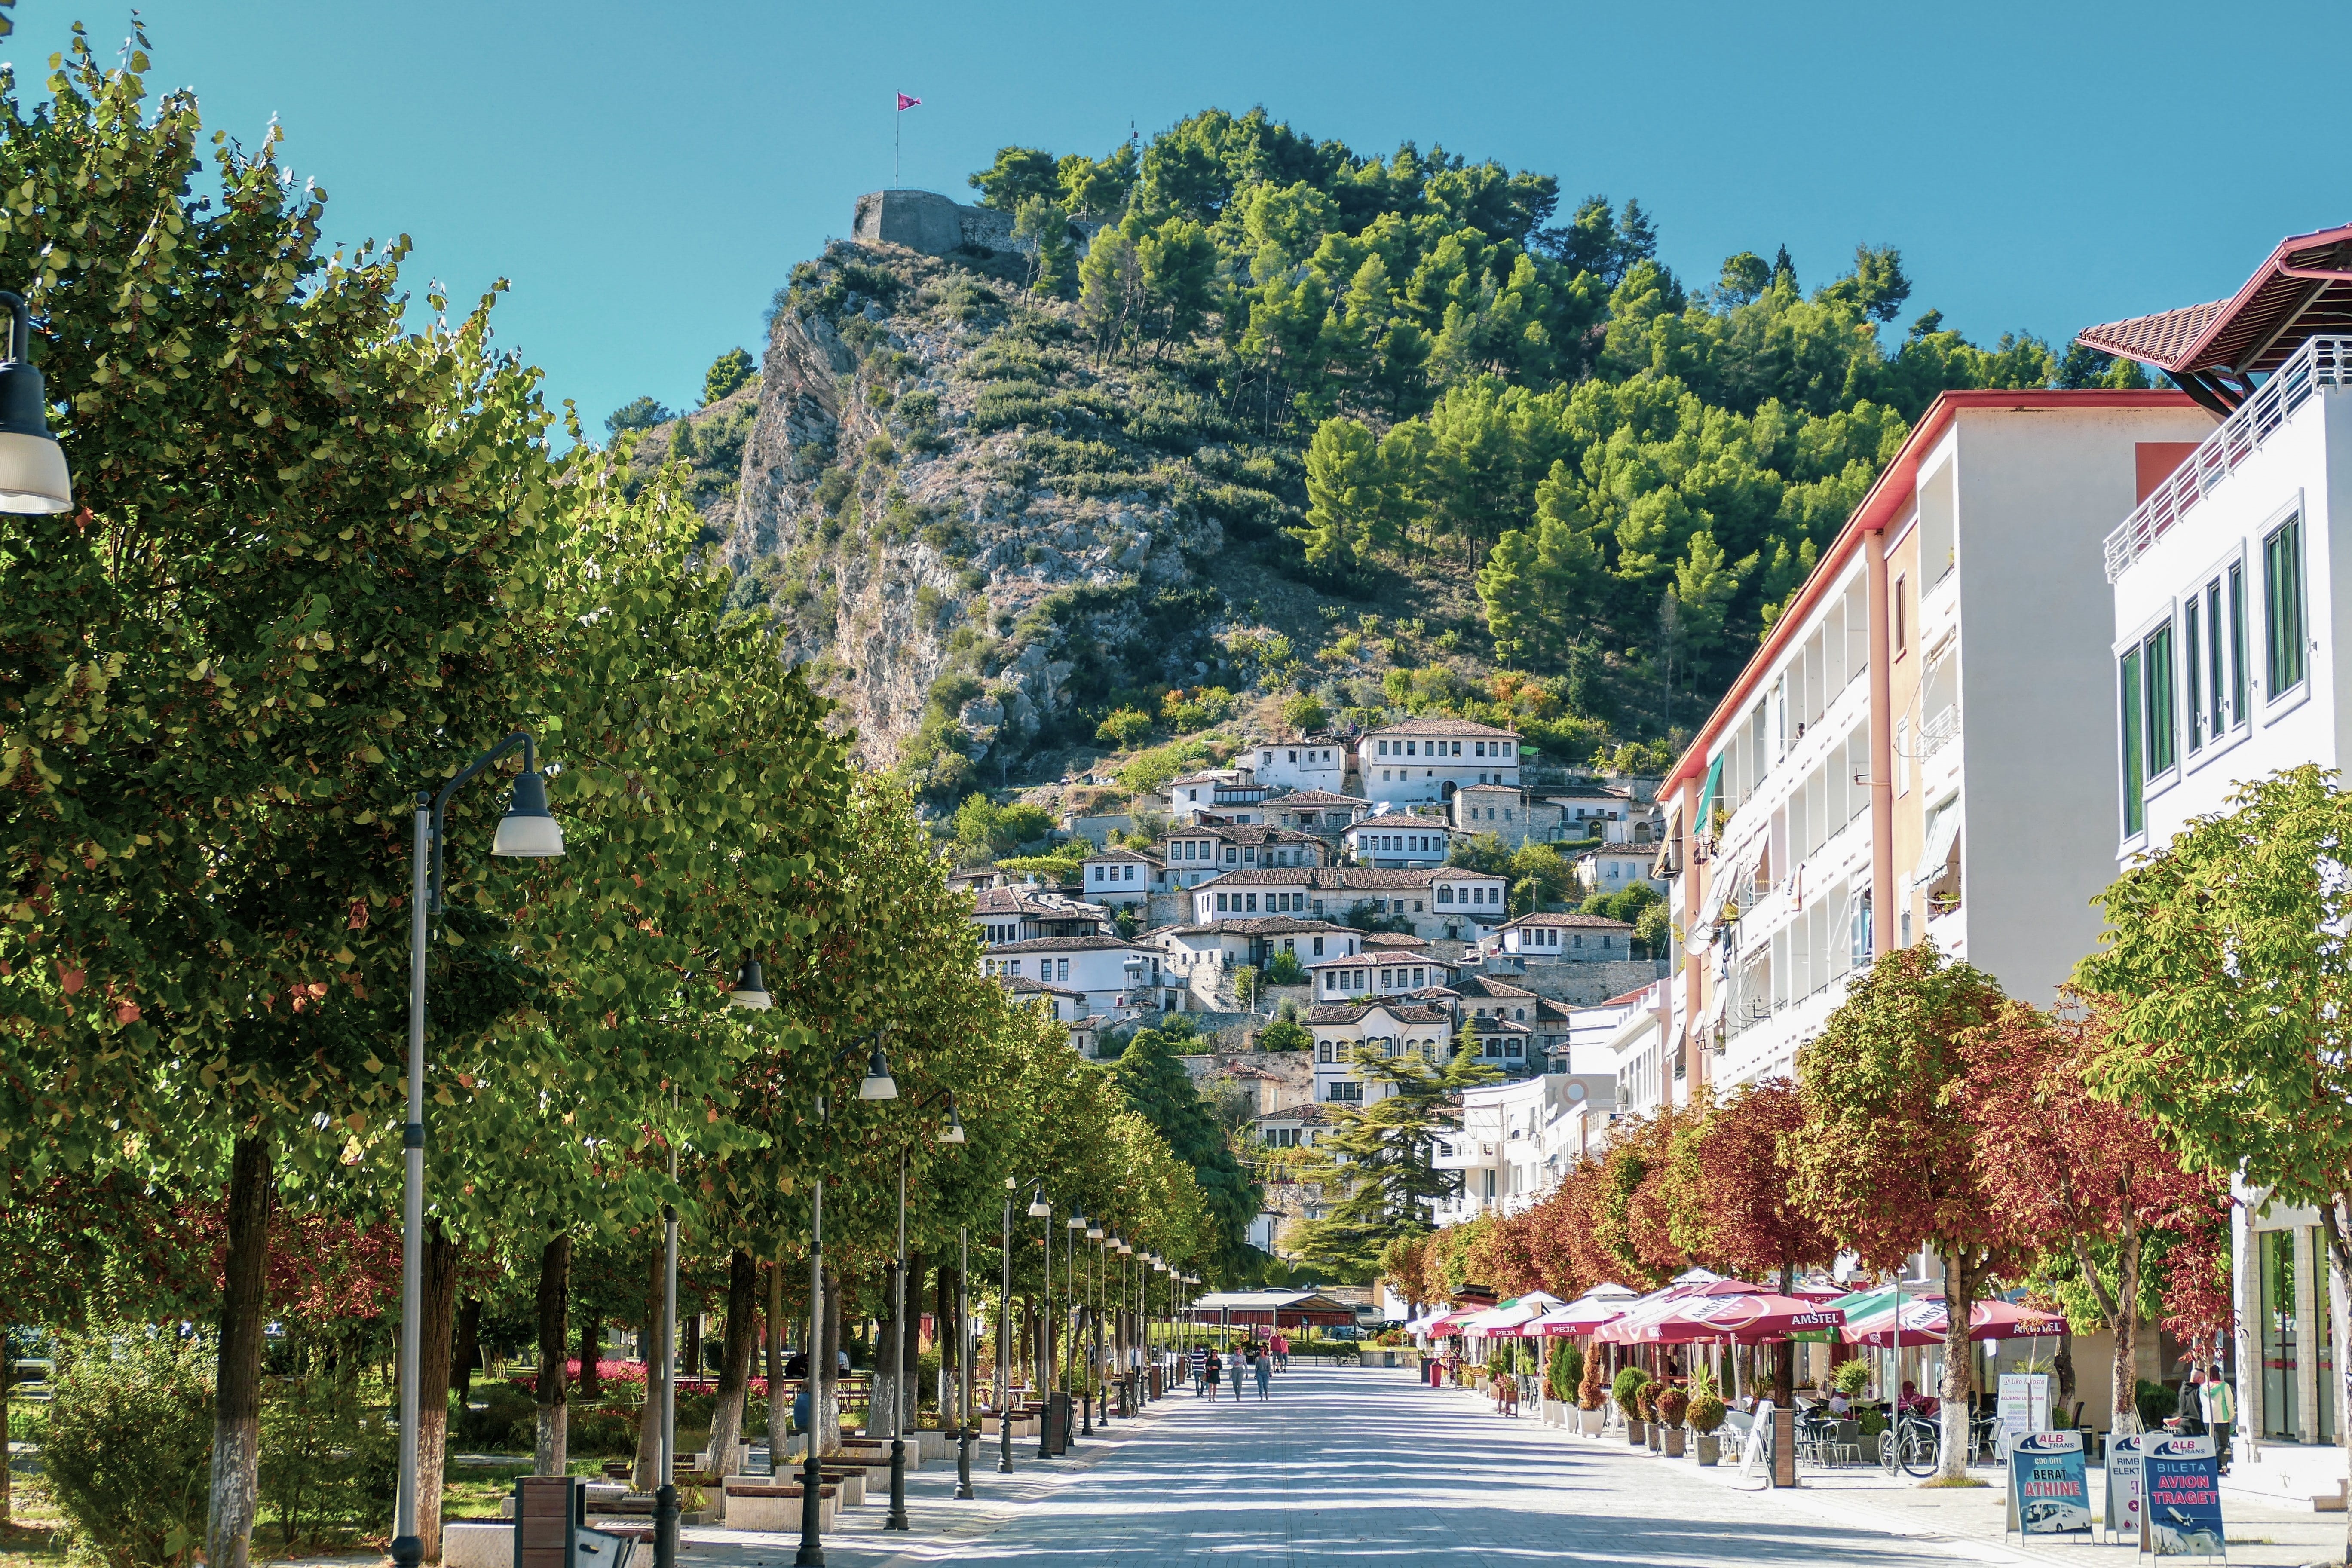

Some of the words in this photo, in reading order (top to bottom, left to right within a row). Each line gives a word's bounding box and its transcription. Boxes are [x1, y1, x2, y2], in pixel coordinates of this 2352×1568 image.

[1692, 1293, 1736, 1319] AMSTEL
[1718, 1303, 1746, 1317] BEER
[1792, 1314, 1839, 1325] AMSTEL
[2039, 1435, 2064, 1443] ALB
[2157, 1463, 2207, 1472] BILETA
[2034, 1469, 2066, 1480] BERAT
[2158, 1476, 2209, 1488] AVION
[2025, 1481, 2081, 1497] ATHINE
[2152, 1491, 2218, 1504] TRAGET
